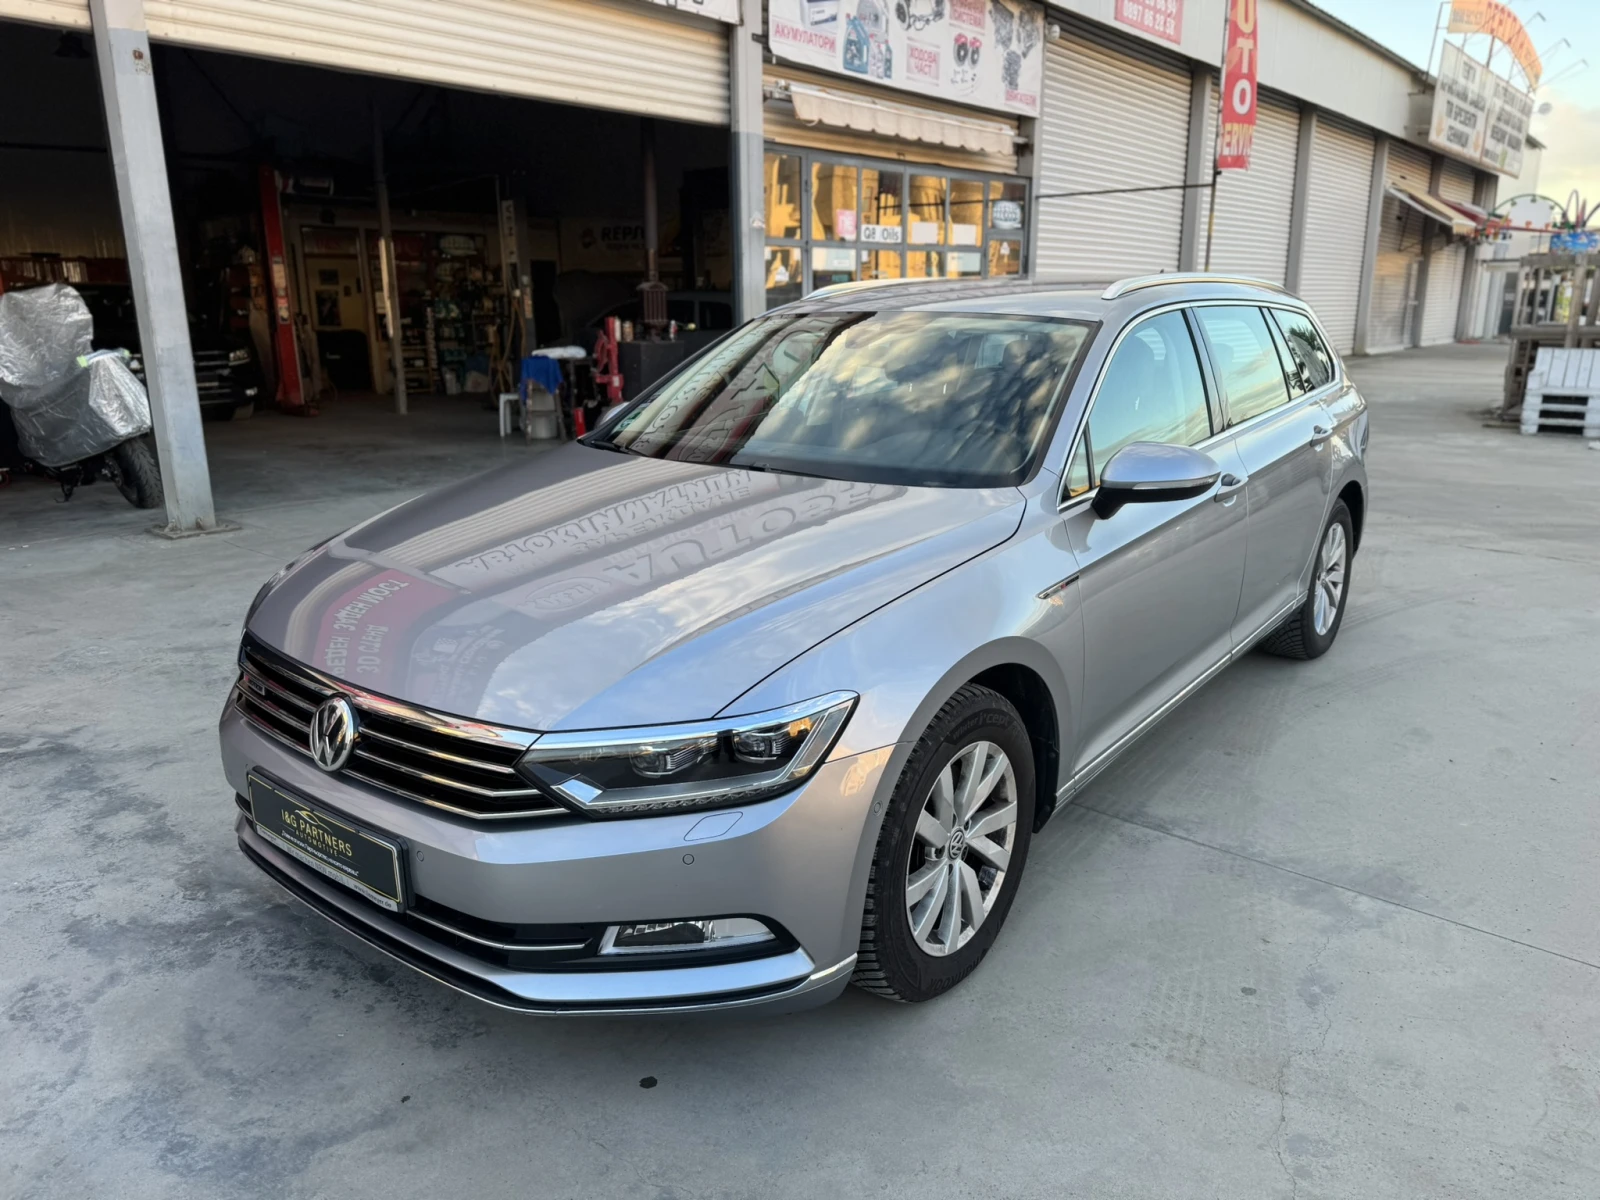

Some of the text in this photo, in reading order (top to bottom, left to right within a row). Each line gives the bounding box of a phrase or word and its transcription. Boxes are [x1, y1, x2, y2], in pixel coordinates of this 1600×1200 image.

[774, 22, 837, 50] АКУМУЛАТОРИ
[909, 47, 938, 63] ХОДОВА
[913, 63, 933, 76] ЧАСТ
[882, 228, 900, 241] Oils
[281, 808, 297, 829] I&G
[300, 820, 353, 857] PARTNERS
[295, 830, 339, 858] AUTOMOTIVE
